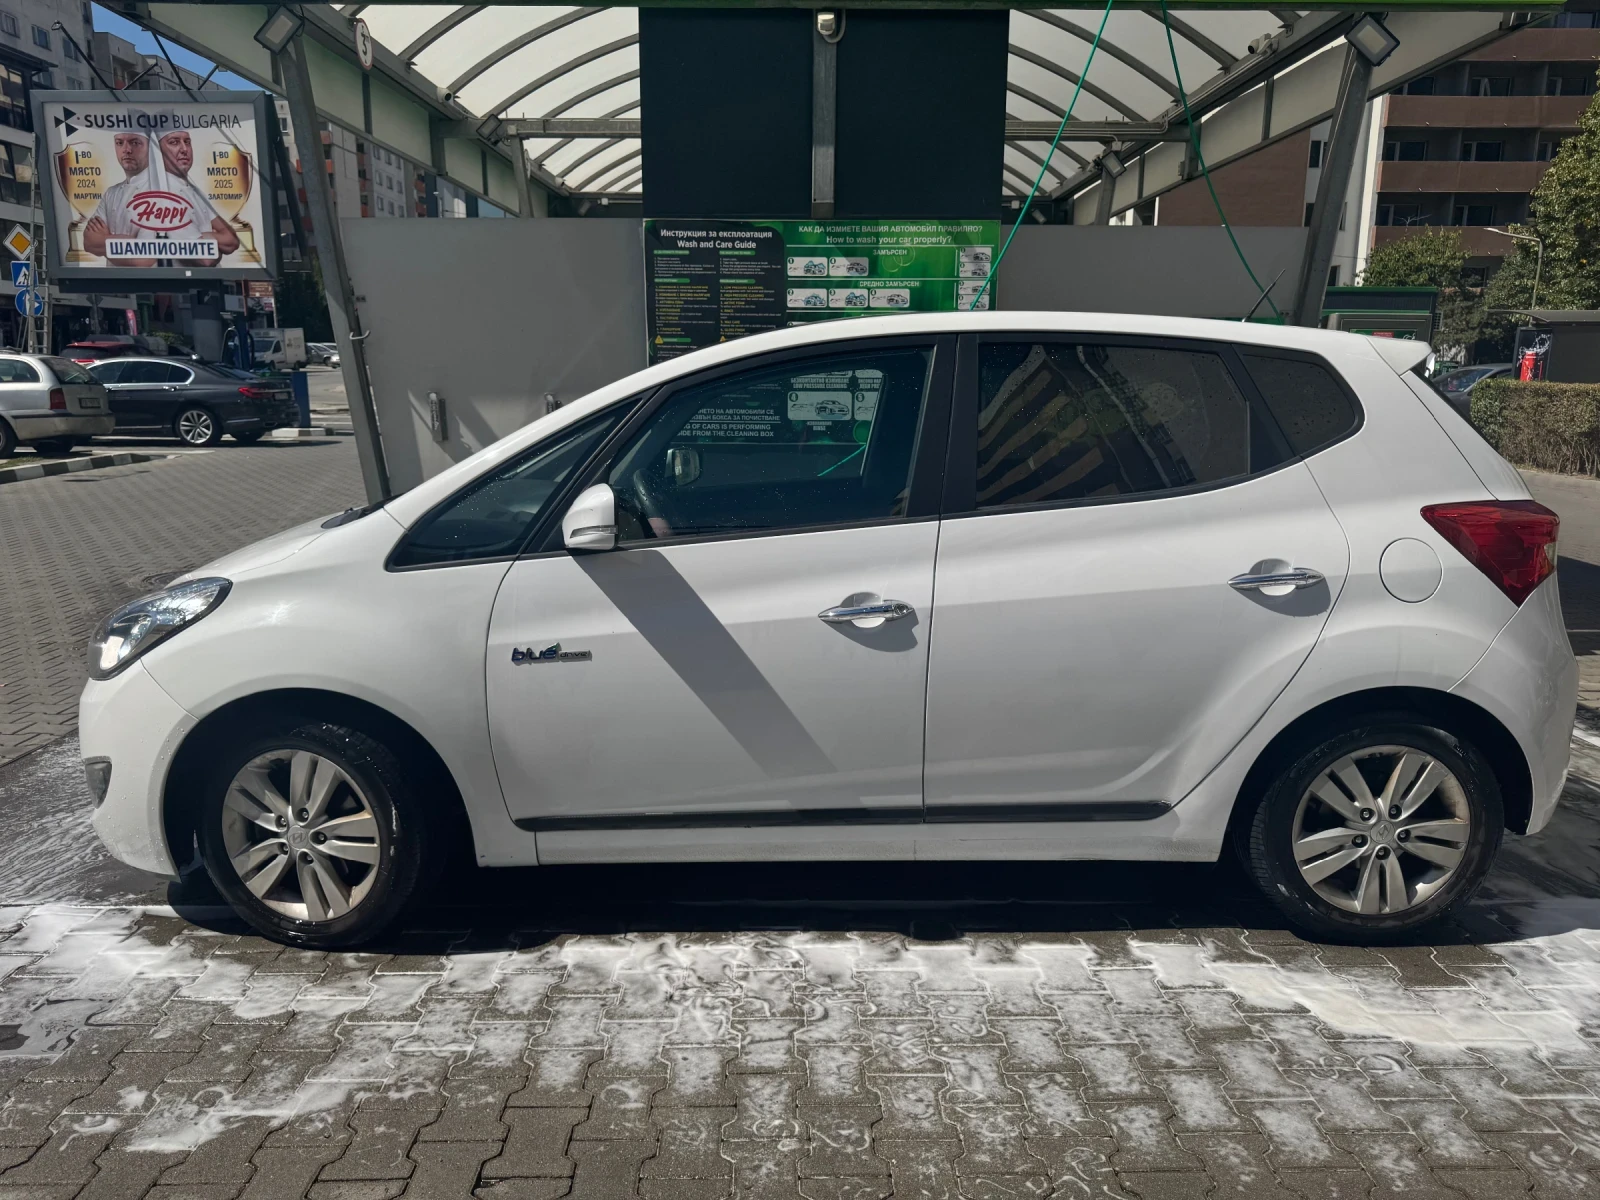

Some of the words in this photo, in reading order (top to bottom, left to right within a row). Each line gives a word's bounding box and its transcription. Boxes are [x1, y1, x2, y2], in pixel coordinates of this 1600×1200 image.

[84, 114, 132, 128] SUSHI
[136, 114, 168, 128] CUP
[174, 114, 241, 129] BULGARIA
[69, 167, 101, 176] МЯСТО
[207, 167, 238, 176] МЯСТО
[77, 180, 96, 188] 2024
[214, 180, 233, 188] 2025
[133, 200, 188, 224] Happy
[661, 229, 706, 238] Инструкция
[914, 236, 952, 245] properly?
[110, 242, 215, 256] ШАМПИОНИТЕ
[512, 646, 557, 662] blue
